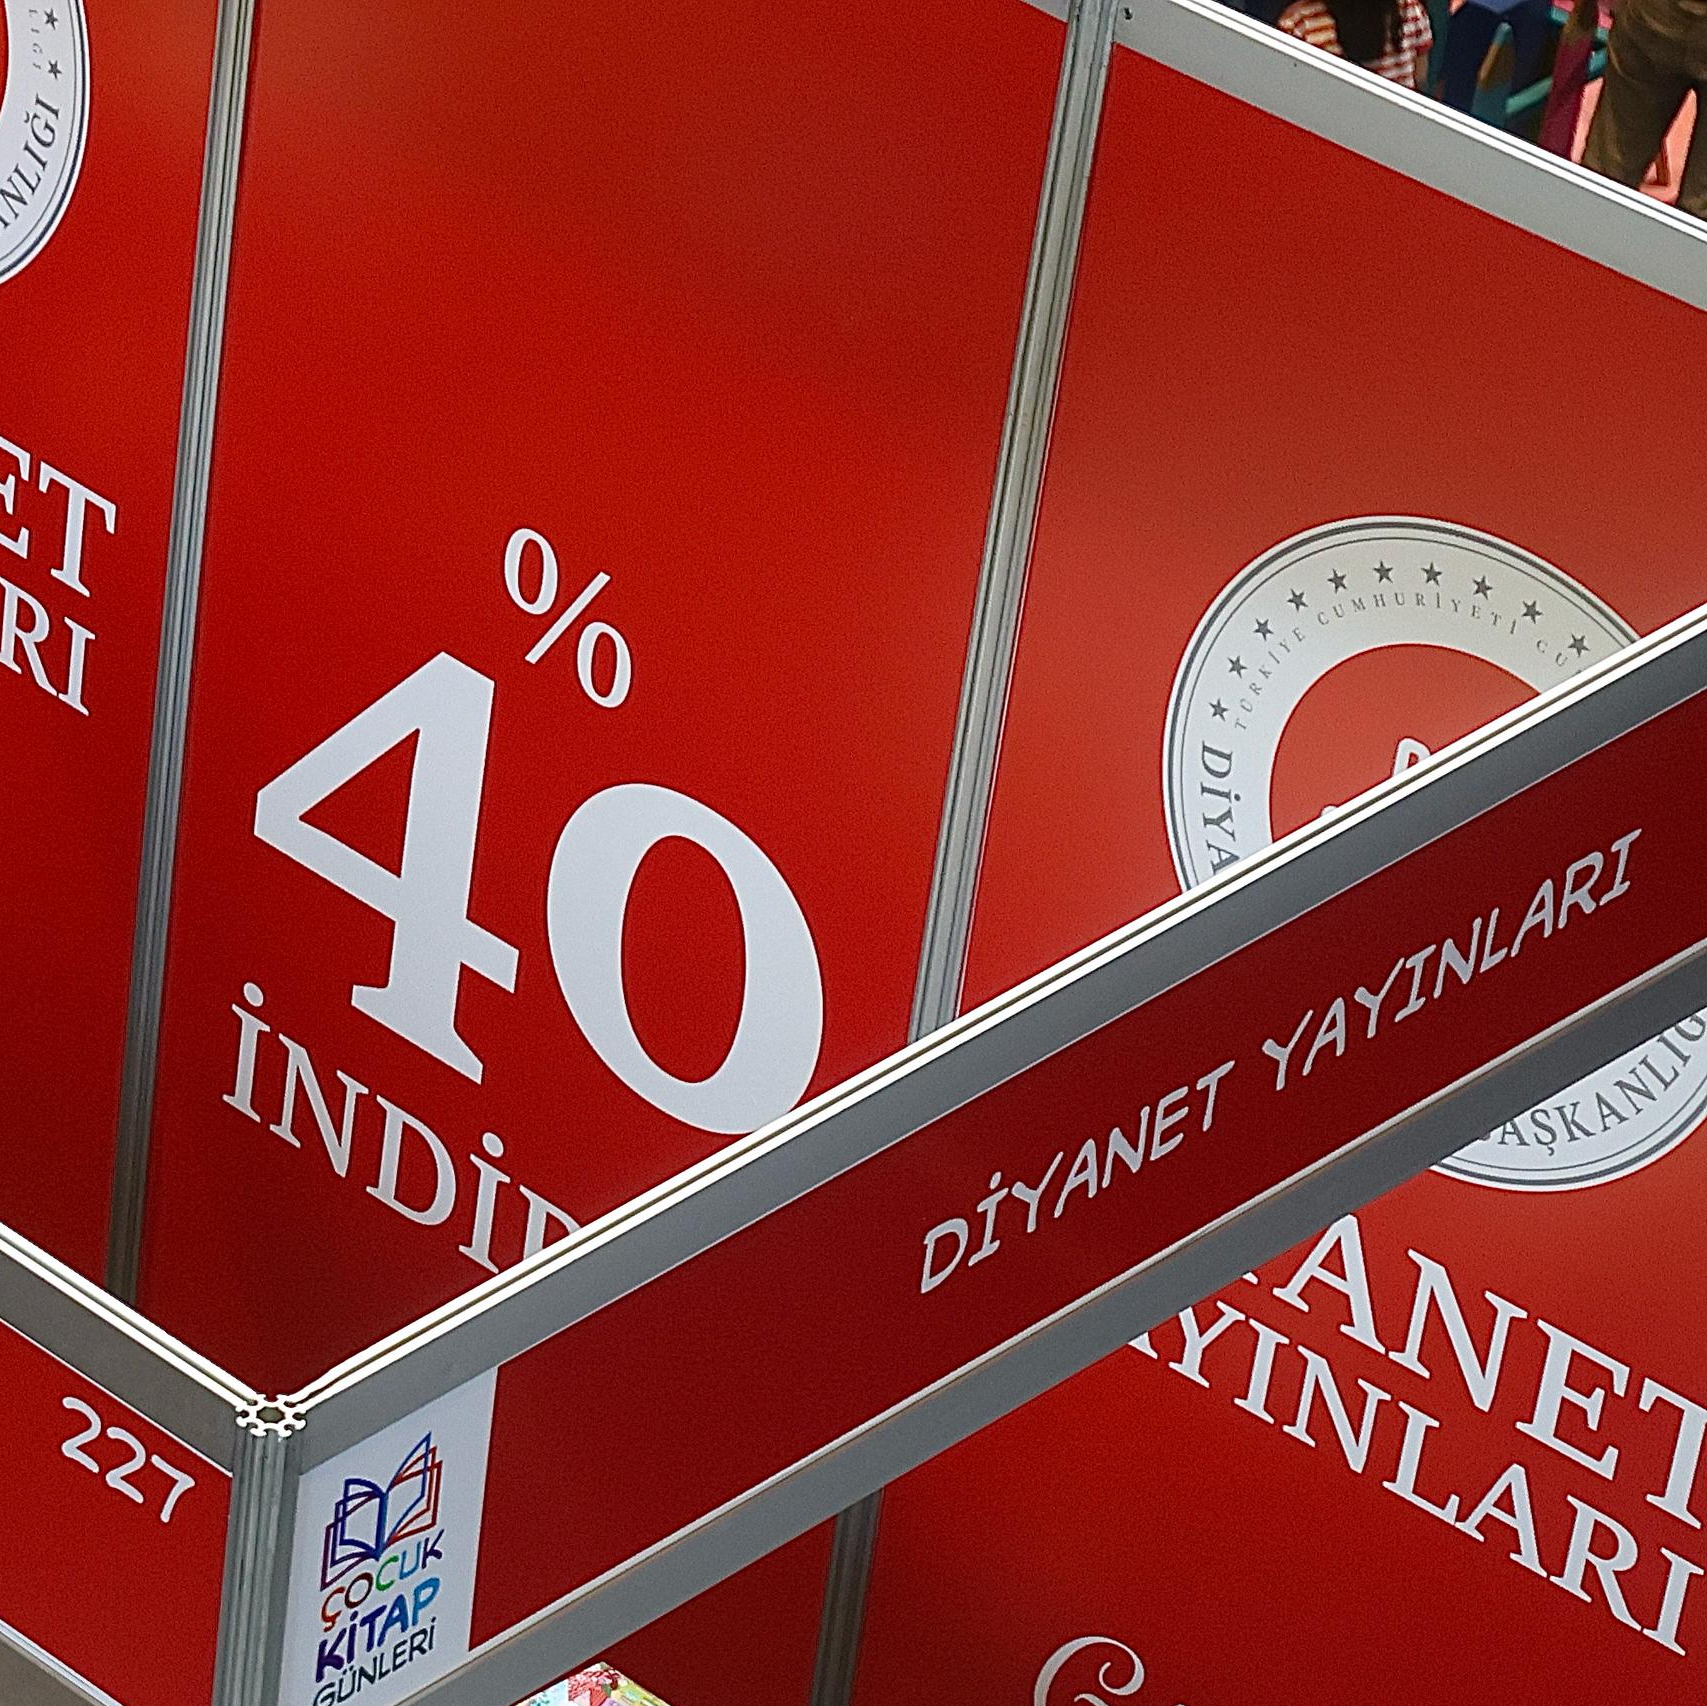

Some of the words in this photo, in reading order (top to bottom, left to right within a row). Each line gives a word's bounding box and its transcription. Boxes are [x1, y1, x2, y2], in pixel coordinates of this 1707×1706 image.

[504, 527, 631, 708] %
[1317, 592, 1517, 635] CUMHURİYETİ
[253, 652, 824, 1134] 40
[920, 1060, 1236, 1294] DİYANET
[1262, 830, 1641, 1092] YAYINLARI
[62, 1397, 195, 1523] 227
[316, 1577, 441, 1684] KİTAP
[321, 1528, 443, 1632] ÇOCUK
